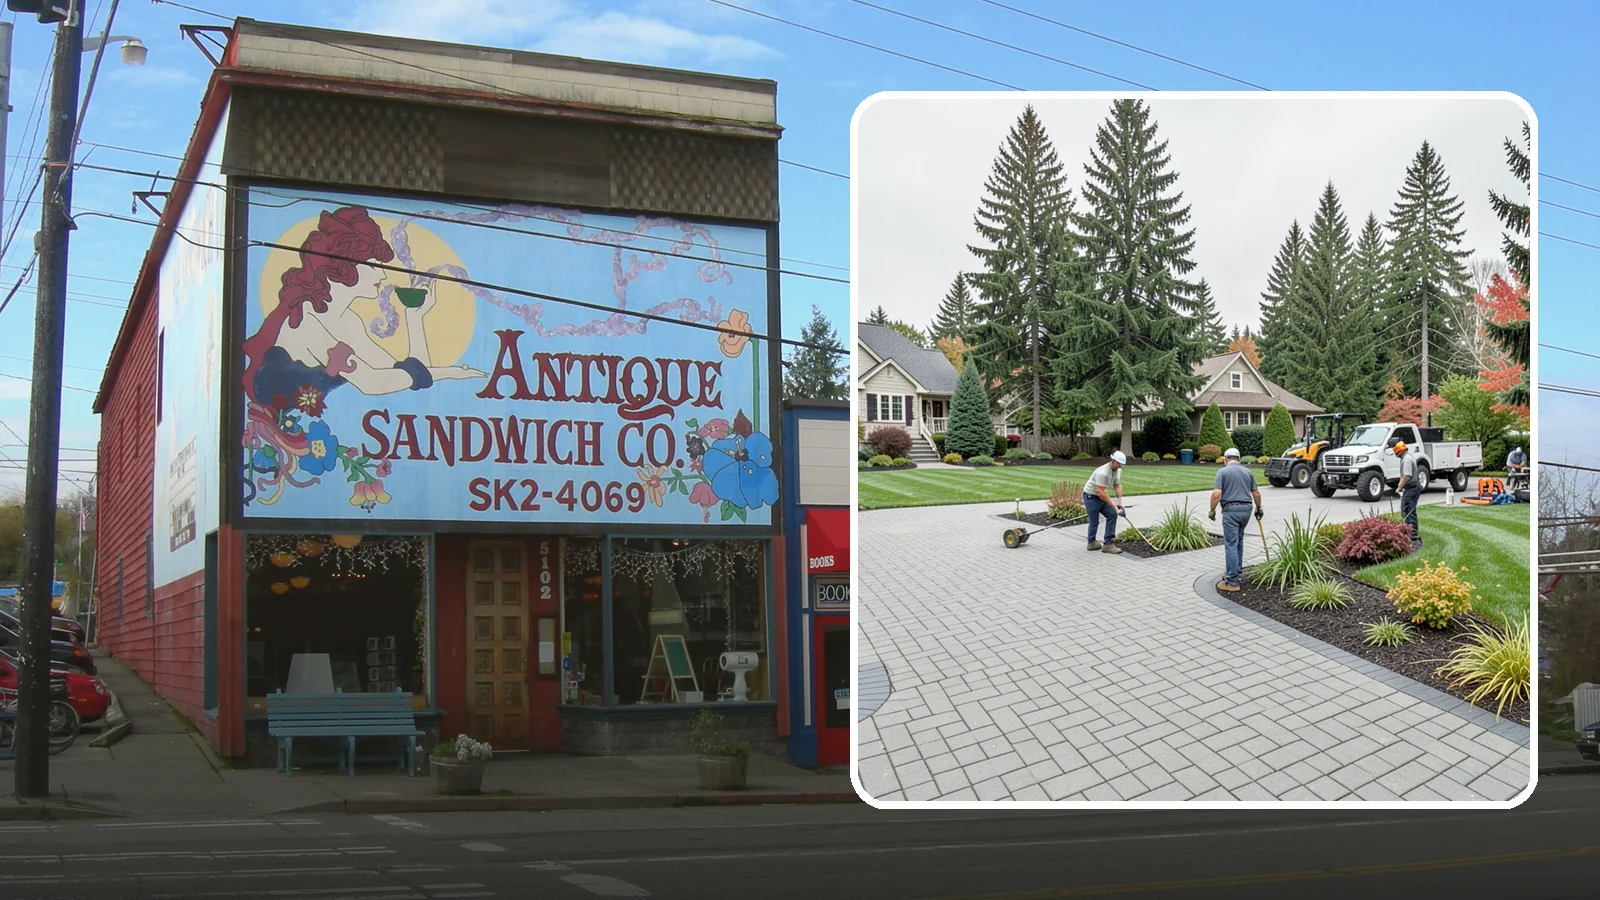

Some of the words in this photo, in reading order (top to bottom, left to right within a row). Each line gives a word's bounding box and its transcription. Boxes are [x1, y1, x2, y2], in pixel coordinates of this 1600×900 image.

[476, 329, 723, 420] ANTIQUE
[361, 408, 604, 467] SANDWICH
[617, 422, 685, 469] CO.
[469, 477, 645, 513] SK2-4069
[540, 541, 551, 599] 5102
[809, 555, 835, 569] BOOKS
